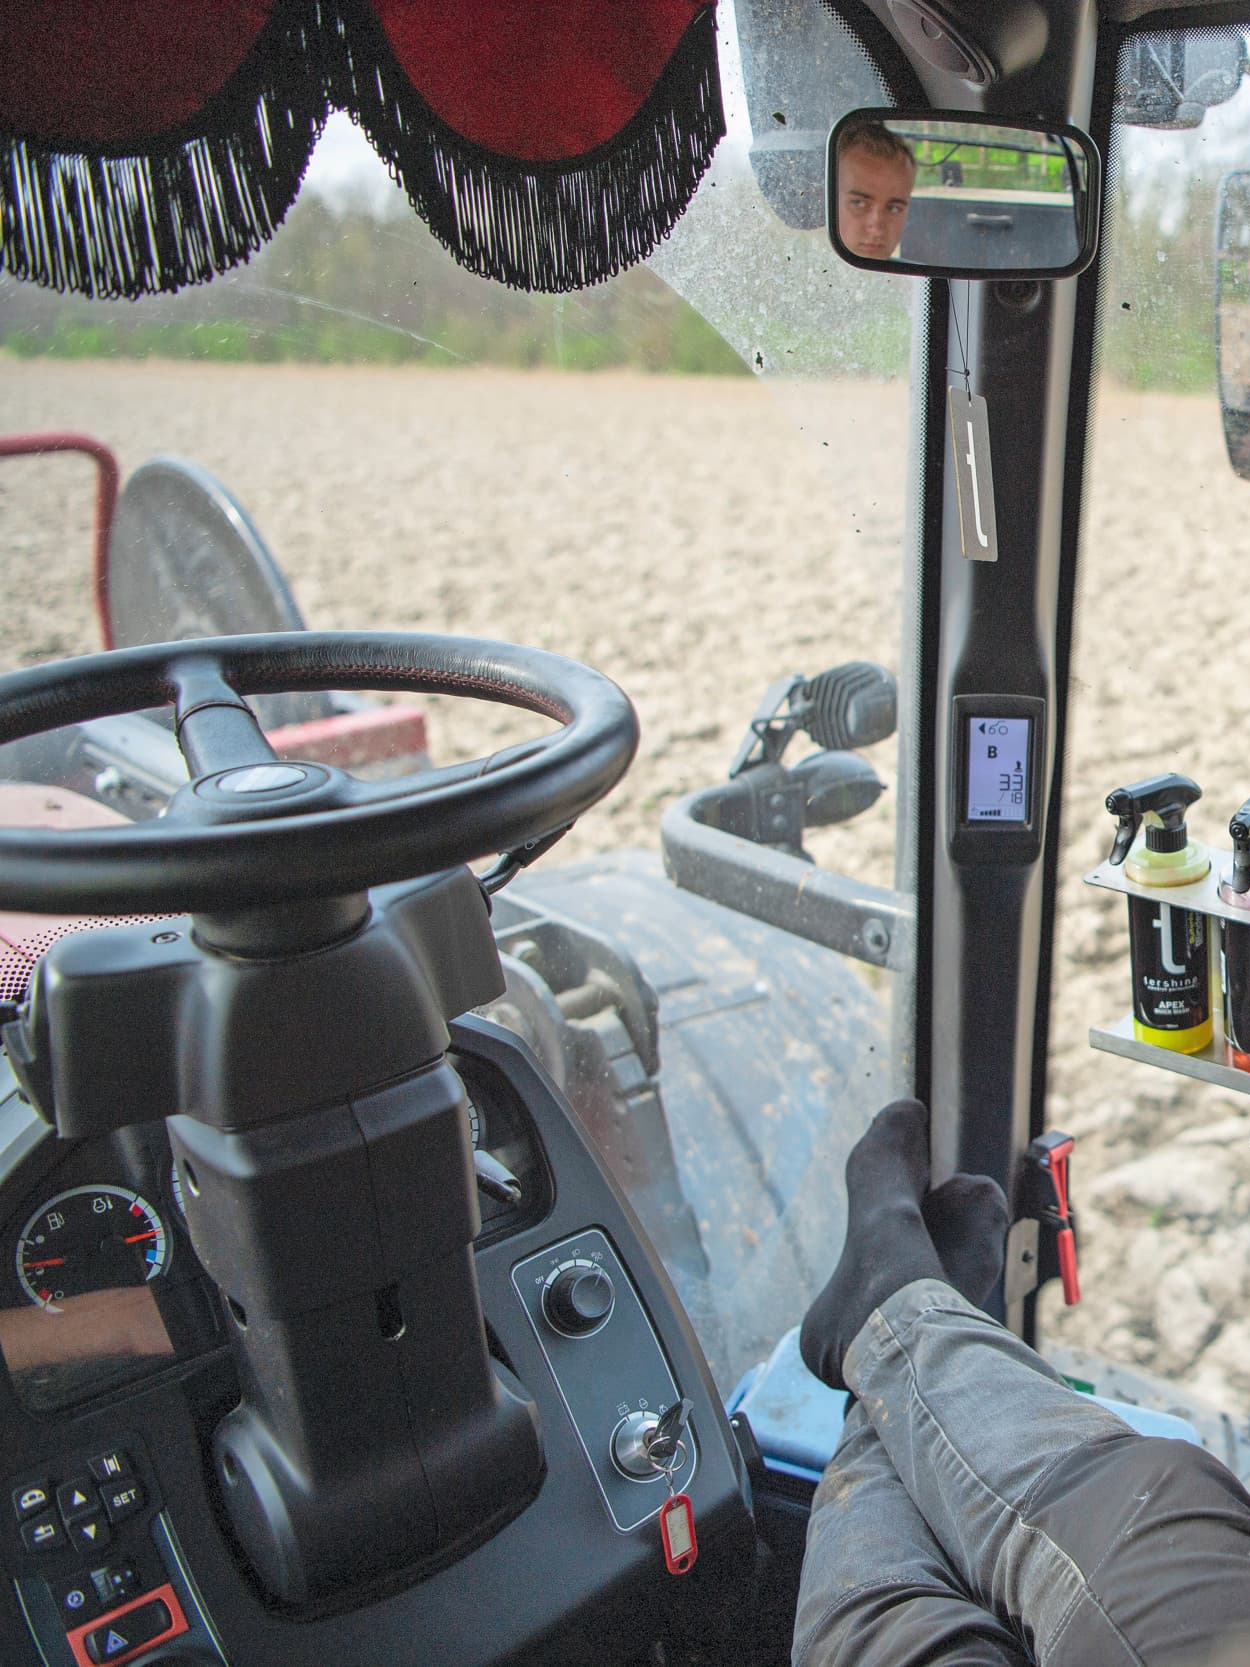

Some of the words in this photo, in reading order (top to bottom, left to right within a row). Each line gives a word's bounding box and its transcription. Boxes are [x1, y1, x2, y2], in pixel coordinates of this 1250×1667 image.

[987, 745, 998, 759] B
[1158, 1000, 1185, 1008] APEX
[112, 1488, 136, 1508] SET
